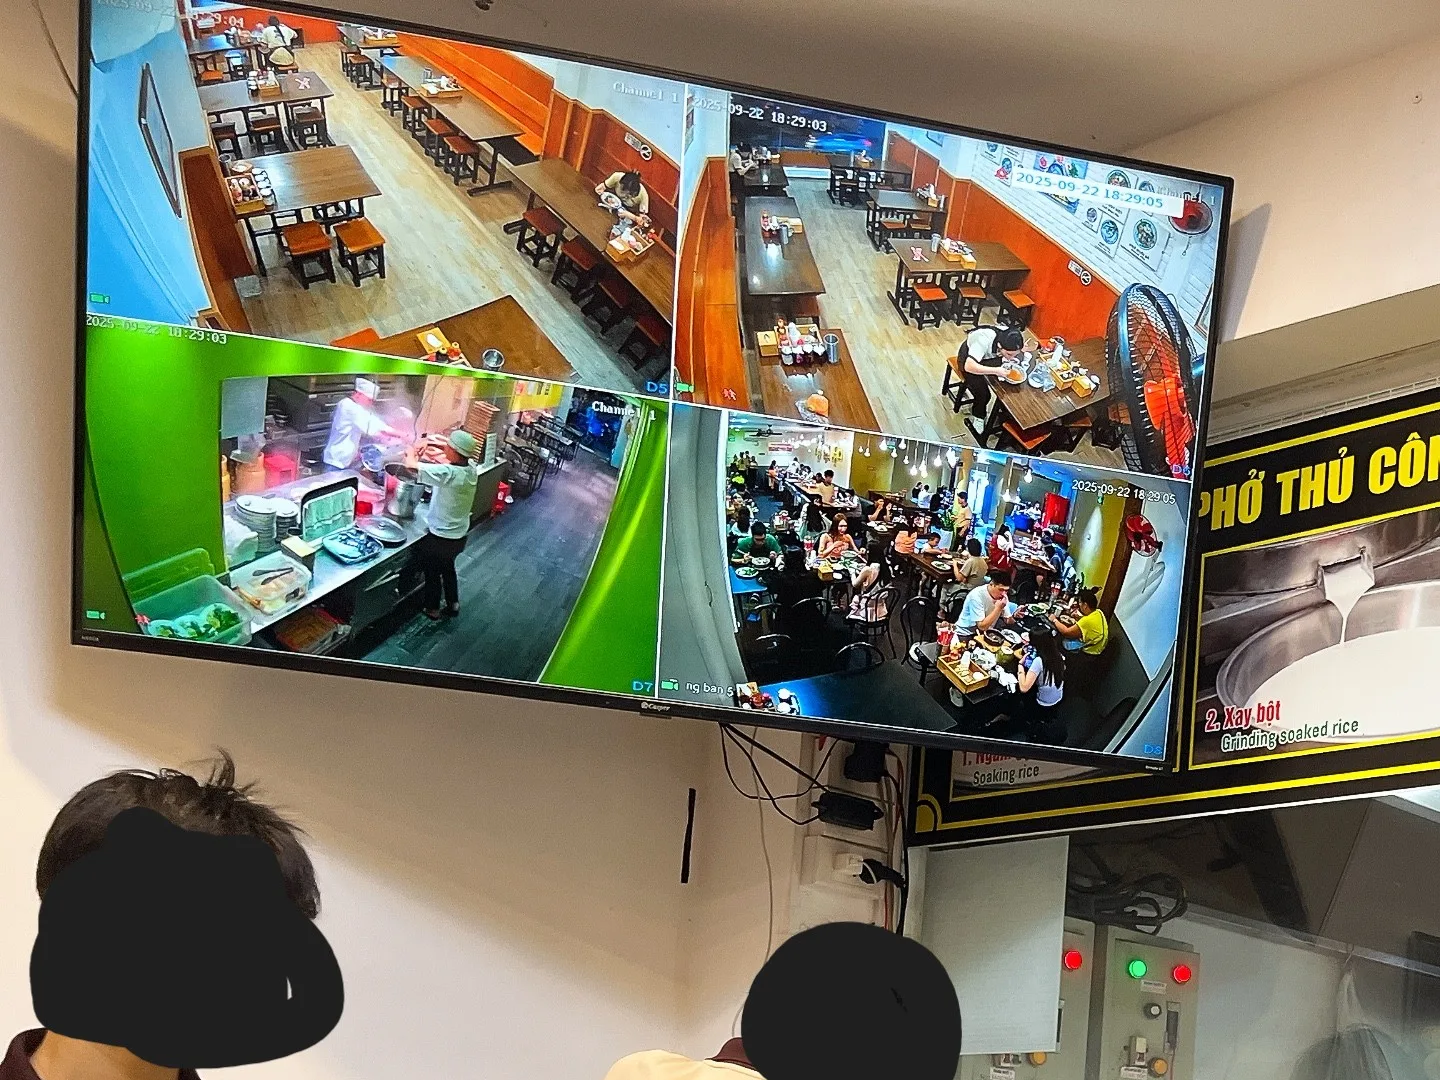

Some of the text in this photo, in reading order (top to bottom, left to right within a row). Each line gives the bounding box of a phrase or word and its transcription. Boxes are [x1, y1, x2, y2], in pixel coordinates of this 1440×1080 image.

[693, 96, 828, 132] 2025-09-22 18:29:03
[1016, 172, 1164, 209] 2025-09-22 18:29:05
[646, 381, 668, 394] D5
[1072, 479, 1130, 498] 2025-09-22
[1276, 446, 1355, 514] THỦ
[632, 680, 654, 693] D7
[686, 682, 700, 694] ng
[703, 682, 724, 694] ban
[1205, 700, 1281, 731] 2. Xay bột
[1222, 718, 1359, 751] Grinding soaked rice
[973, 764, 1040, 785] Soaking rice
